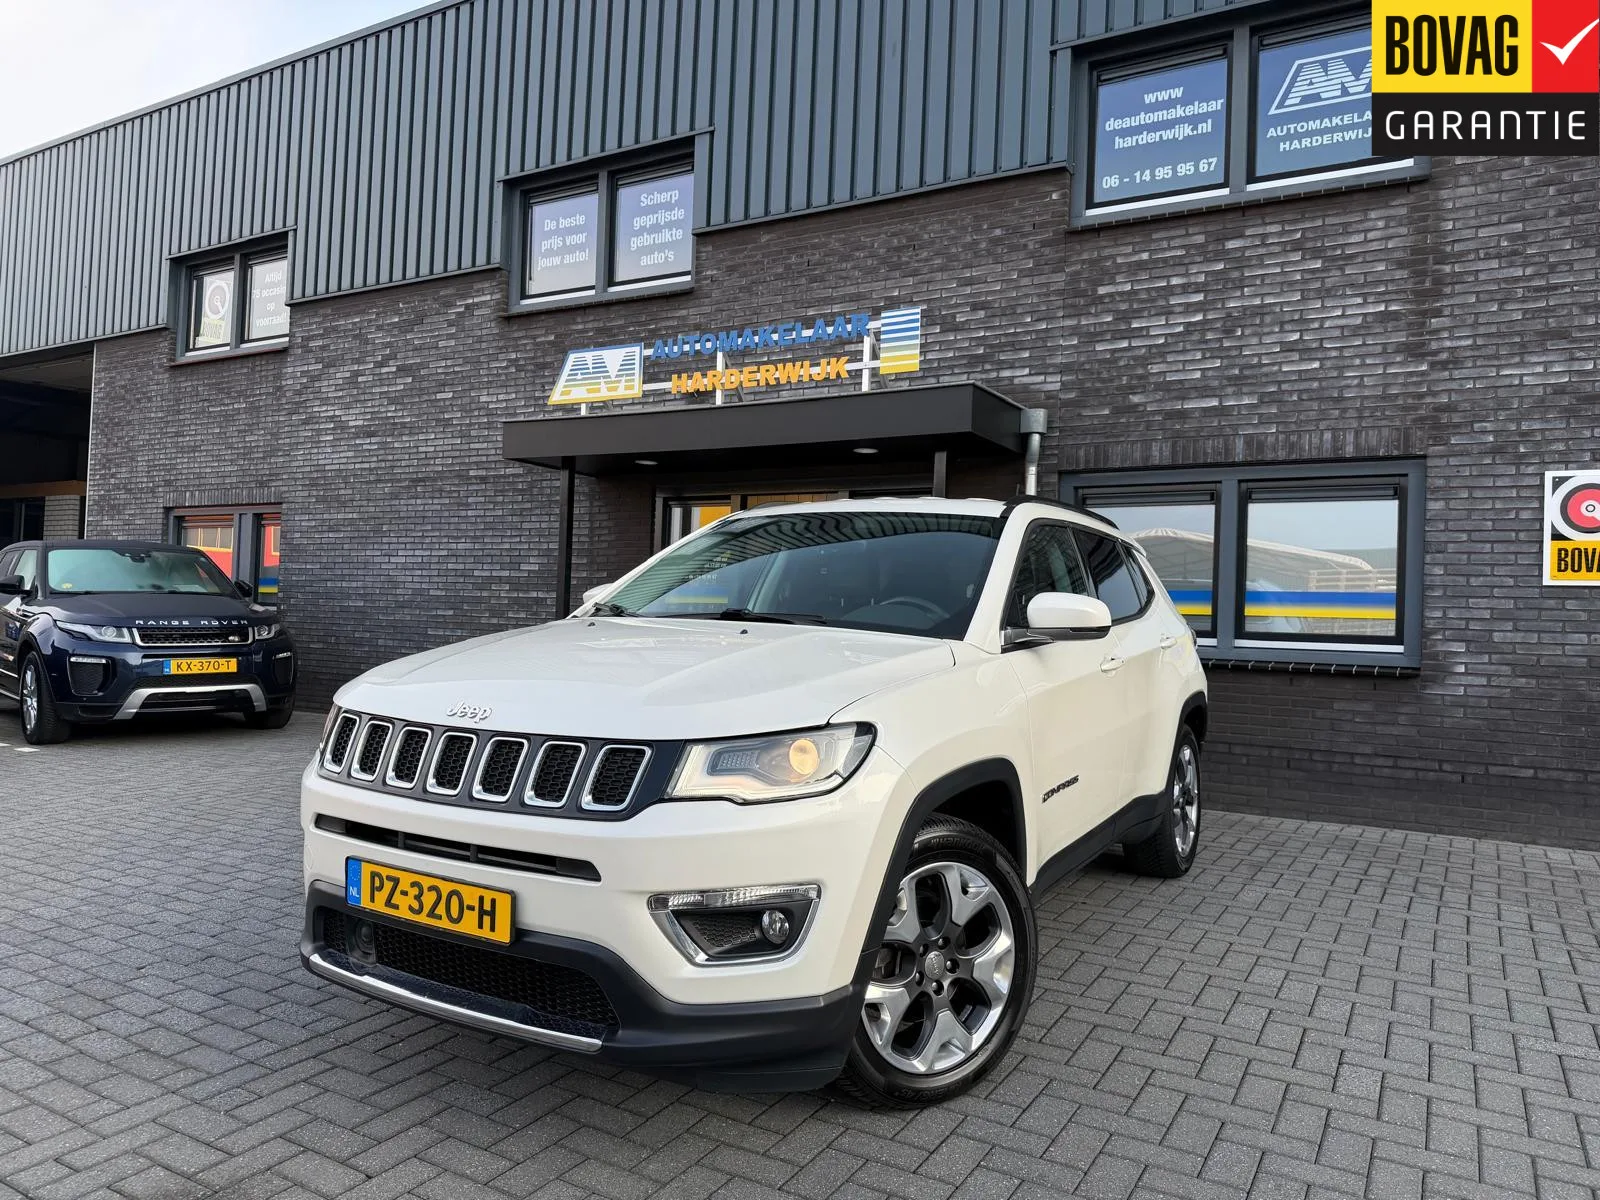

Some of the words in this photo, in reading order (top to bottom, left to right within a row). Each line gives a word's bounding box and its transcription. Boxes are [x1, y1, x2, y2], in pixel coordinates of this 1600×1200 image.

[1144, 87, 1183, 104] www
[1105, 99, 1224, 131] deautomakelaar
[1114, 119, 1212, 149] harderwijk.nl
[1102, 175, 1119, 188] 06
[1134, 169, 1151, 183] 14
[1155, 165, 1172, 180] 95
[1176, 162, 1194, 176] 95
[1199, 157, 1218, 172] 67
[640, 190, 679, 207] Scherp
[544, 219, 557, 231] De
[559, 213, 586, 229] beste
[633, 206, 685, 230] geprijsde
[541, 235, 563, 253] prijs
[565, 231, 588, 246] voor
[630, 227, 683, 251] gebruikte
[537, 254, 562, 271] jouw
[563, 248, 589, 264] auto!
[640, 249, 675, 266] auto's
[651, 313, 871, 361] AUTOMAKELAAR
[671, 356, 850, 395] HARDERWIJK
[176, 660, 232, 673] KX-370-T
[446, 701, 493, 724] Jeep
[349, 886, 360, 898] NL
[369, 870, 498, 933] PZ-320-H
